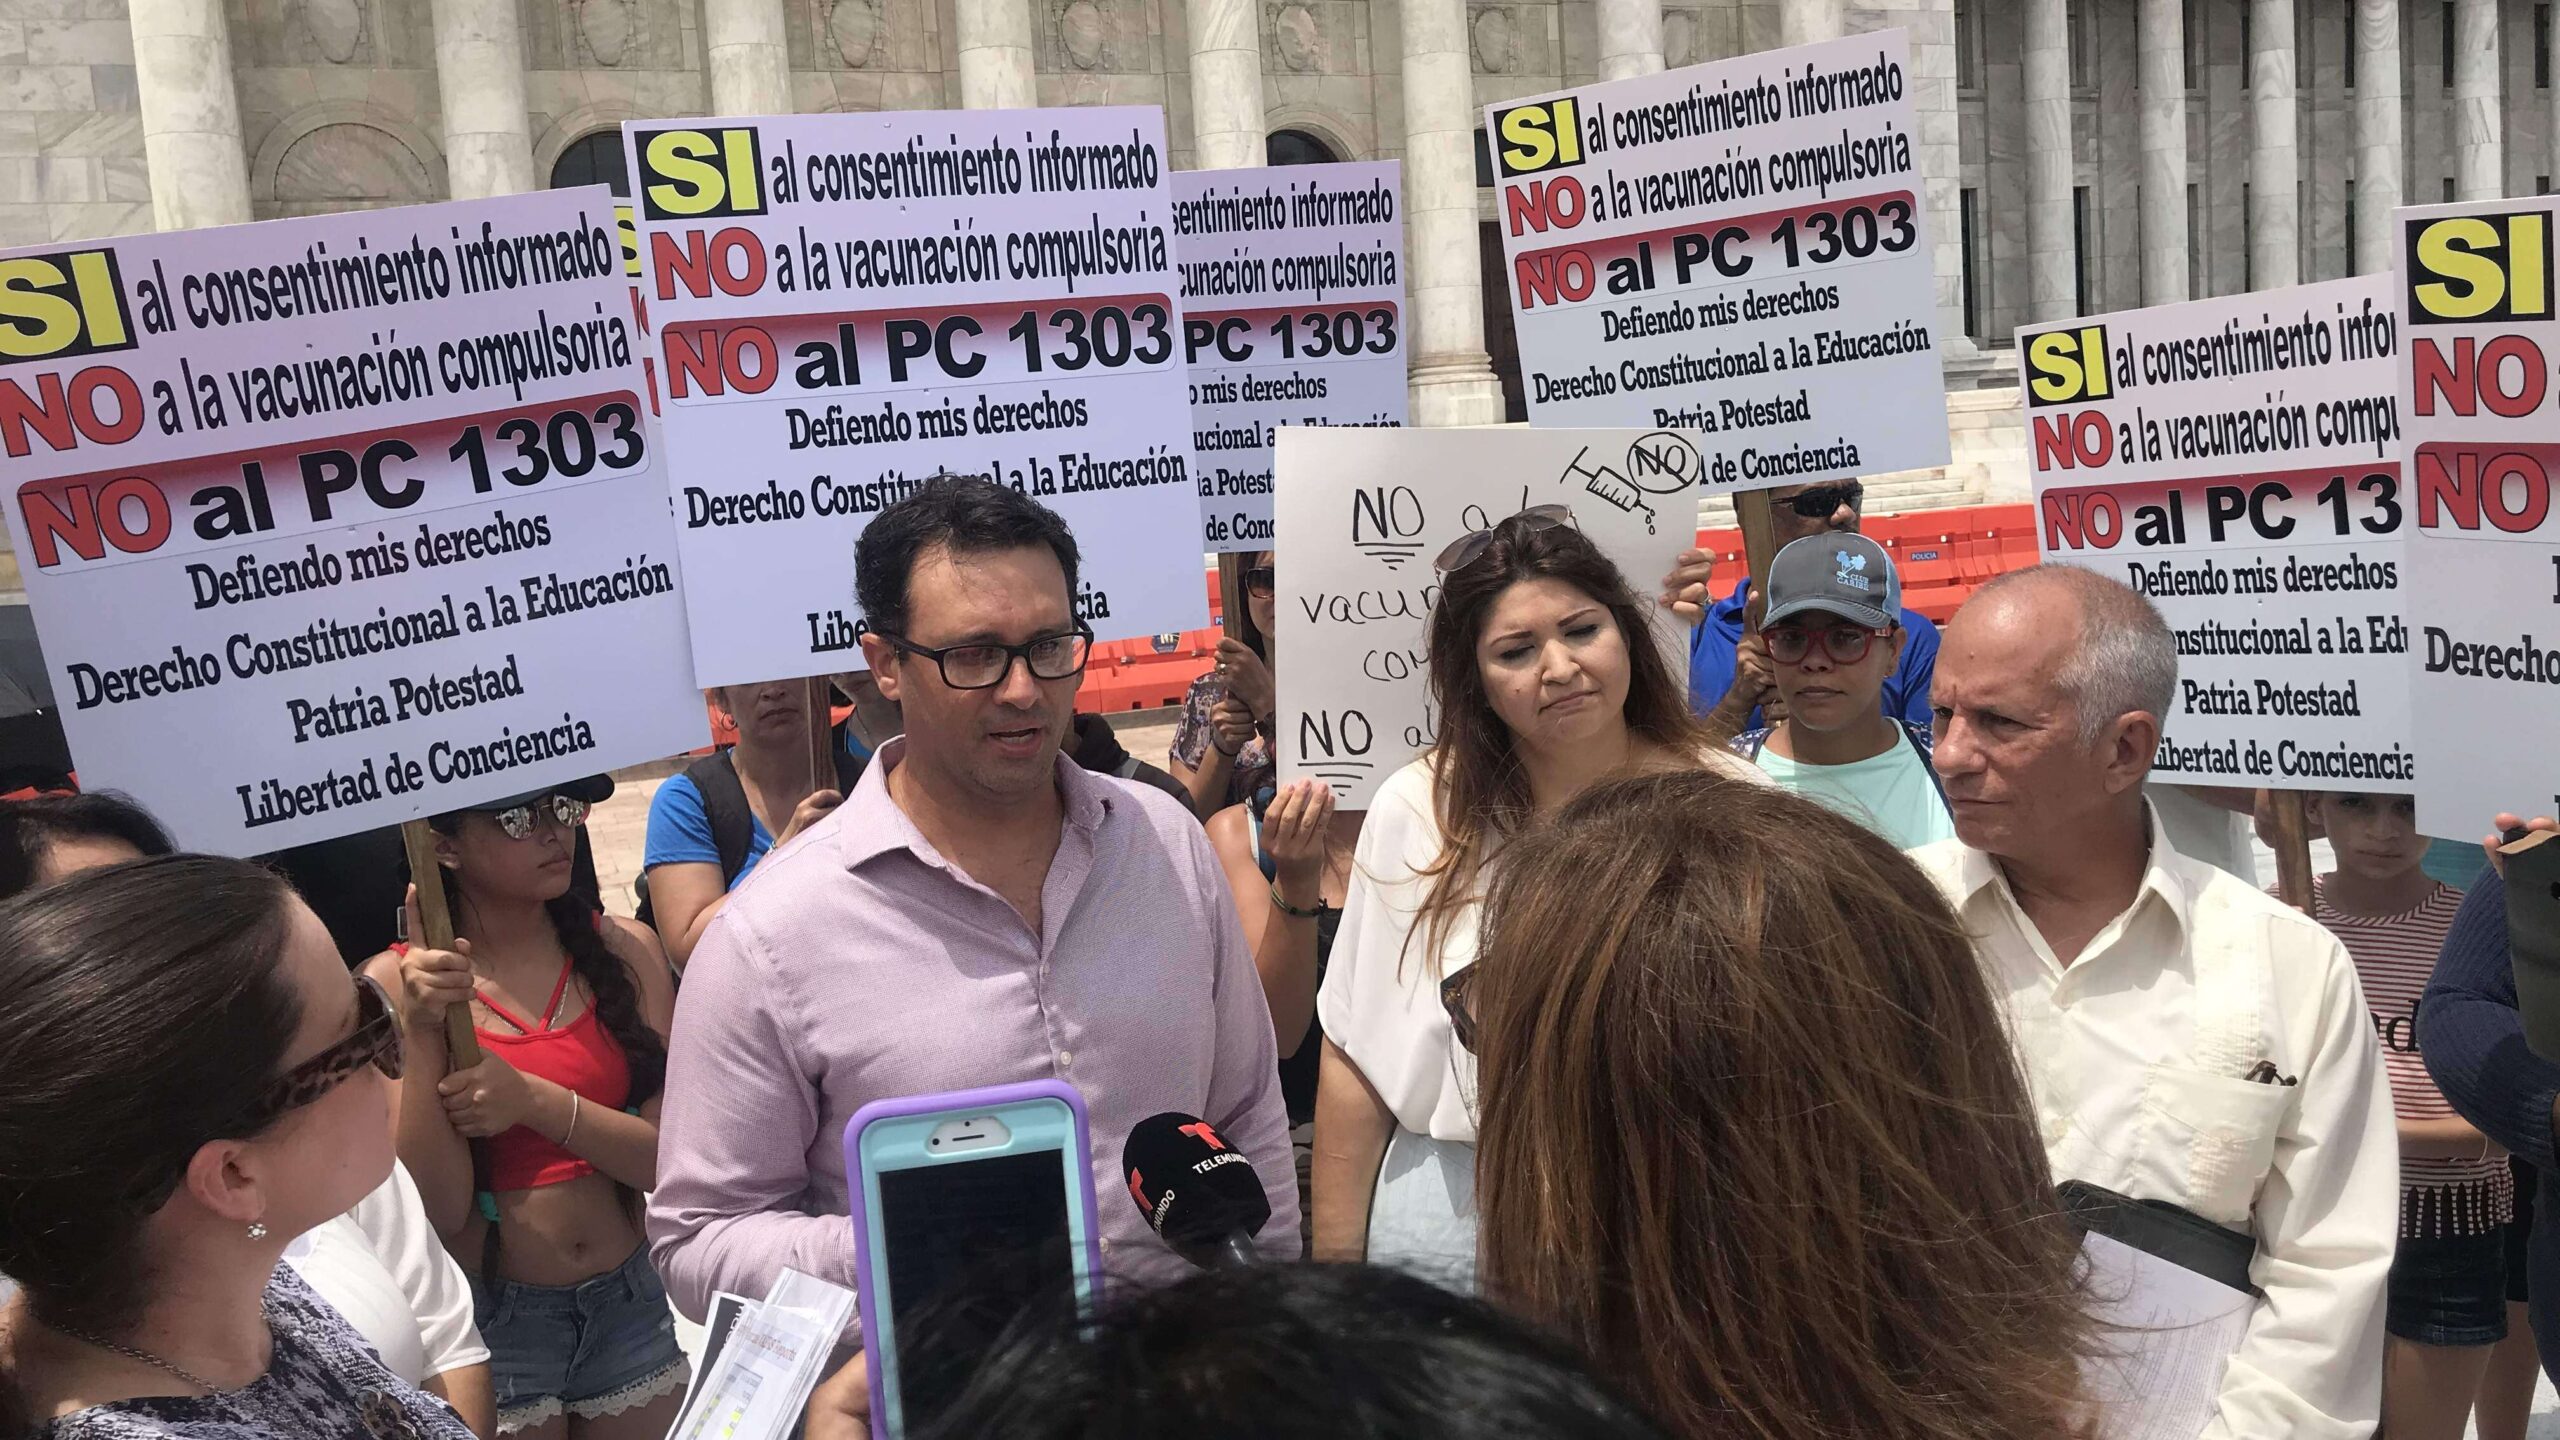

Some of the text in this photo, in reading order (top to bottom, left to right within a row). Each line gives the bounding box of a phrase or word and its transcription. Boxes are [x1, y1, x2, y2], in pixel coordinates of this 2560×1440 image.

[1501, 51, 1902, 172] SI al consentimiento informado
[645, 129, 1157, 215] SI al consentimiento informado
[1291, 178, 1392, 227] informado
[1505, 122, 1911, 237] NO a la vacunación compulsoria
[0, 251, 127, 357] SI
[137, 259, 176, 334] al
[183, 234, 450, 328] consentimiento
[452, 211, 611, 294] informado
[650, 227, 767, 300] NO
[775, 244, 795, 293] a
[799, 226, 831, 290] la
[835, 217, 1000, 288] vacunación
[1007, 211, 1167, 293] compulsoria
[1272, 240, 1396, 301] compulsoria
[1515, 200, 1917, 309] NO al PC 1303
[2415, 215, 2545, 318] SI
[663, 325, 779, 399] NO
[795, 324, 860, 389] al
[885, 314, 987, 382] PC
[1008, 302, 1173, 373] 1303
[1185, 308, 1397, 364] PC 1303
[1601, 281, 1839, 342] Defiendo mis derechos
[0, 365, 145, 458] NO
[153, 381, 183, 435] a
[180, 358, 227, 430] la
[228, 329, 433, 423] vacunación
[439, 302, 631, 401] compulsoria
[1202, 375, 1237, 404] mis
[1242, 371, 1326, 401] derechos
[1532, 320, 1930, 403] Derecho Constitucional a la Educación
[2029, 329, 2109, 400] SI
[2116, 333, 2137, 388] al
[2143, 310, 2331, 385] consentimiento
[2412, 334, 2548, 418] NO
[785, 390, 1087, 449] Defiendo mis derechos
[1719, 389, 1810, 430] Potestad
[2033, 410, 2113, 472] NO
[2120, 423, 2134, 464] a
[2137, 406, 2163, 463] la
[2165, 390, 2309, 459] vacunación
[18, 401, 645, 568] NO al PC 1303
[684, 480, 804, 528] Derecho
[1009, 470, 1026, 496] a
[1028, 458, 1057, 496] la
[1059, 445, 1187, 493] Educación
[1217, 465, 1275, 495] Potest
[1712, 453, 1737, 483] de
[1741, 437, 1860, 479] Conciencia
[2417, 452, 2550, 533] NO
[1206, 515, 1228, 541] de
[1353, 485, 1495, 543] NO a
[2041, 473, 2401, 551] NO al PC 13
[185, 510, 551, 609] Defiendo mis derechos
[1836, 577, 1869, 591] CARIBE
[1850, 573, 1869, 583] CLUB
[2129, 553, 2397, 600] Defiendo mis derechos
[67, 554, 673, 710] Derecho Constitucional a la Educación
[2317, 628, 2333, 654] a
[2336, 617, 2364, 653] la
[2425, 627, 2560, 686] Derecho
[287, 654, 524, 743] Patria Potestad
[1300, 705, 1438, 760] NO al
[2182, 679, 2360, 716] Patria Potestad
[236, 713, 595, 828] Libertad de Conciencia
[2151, 736, 2415, 781] ibertad de Conciencia
